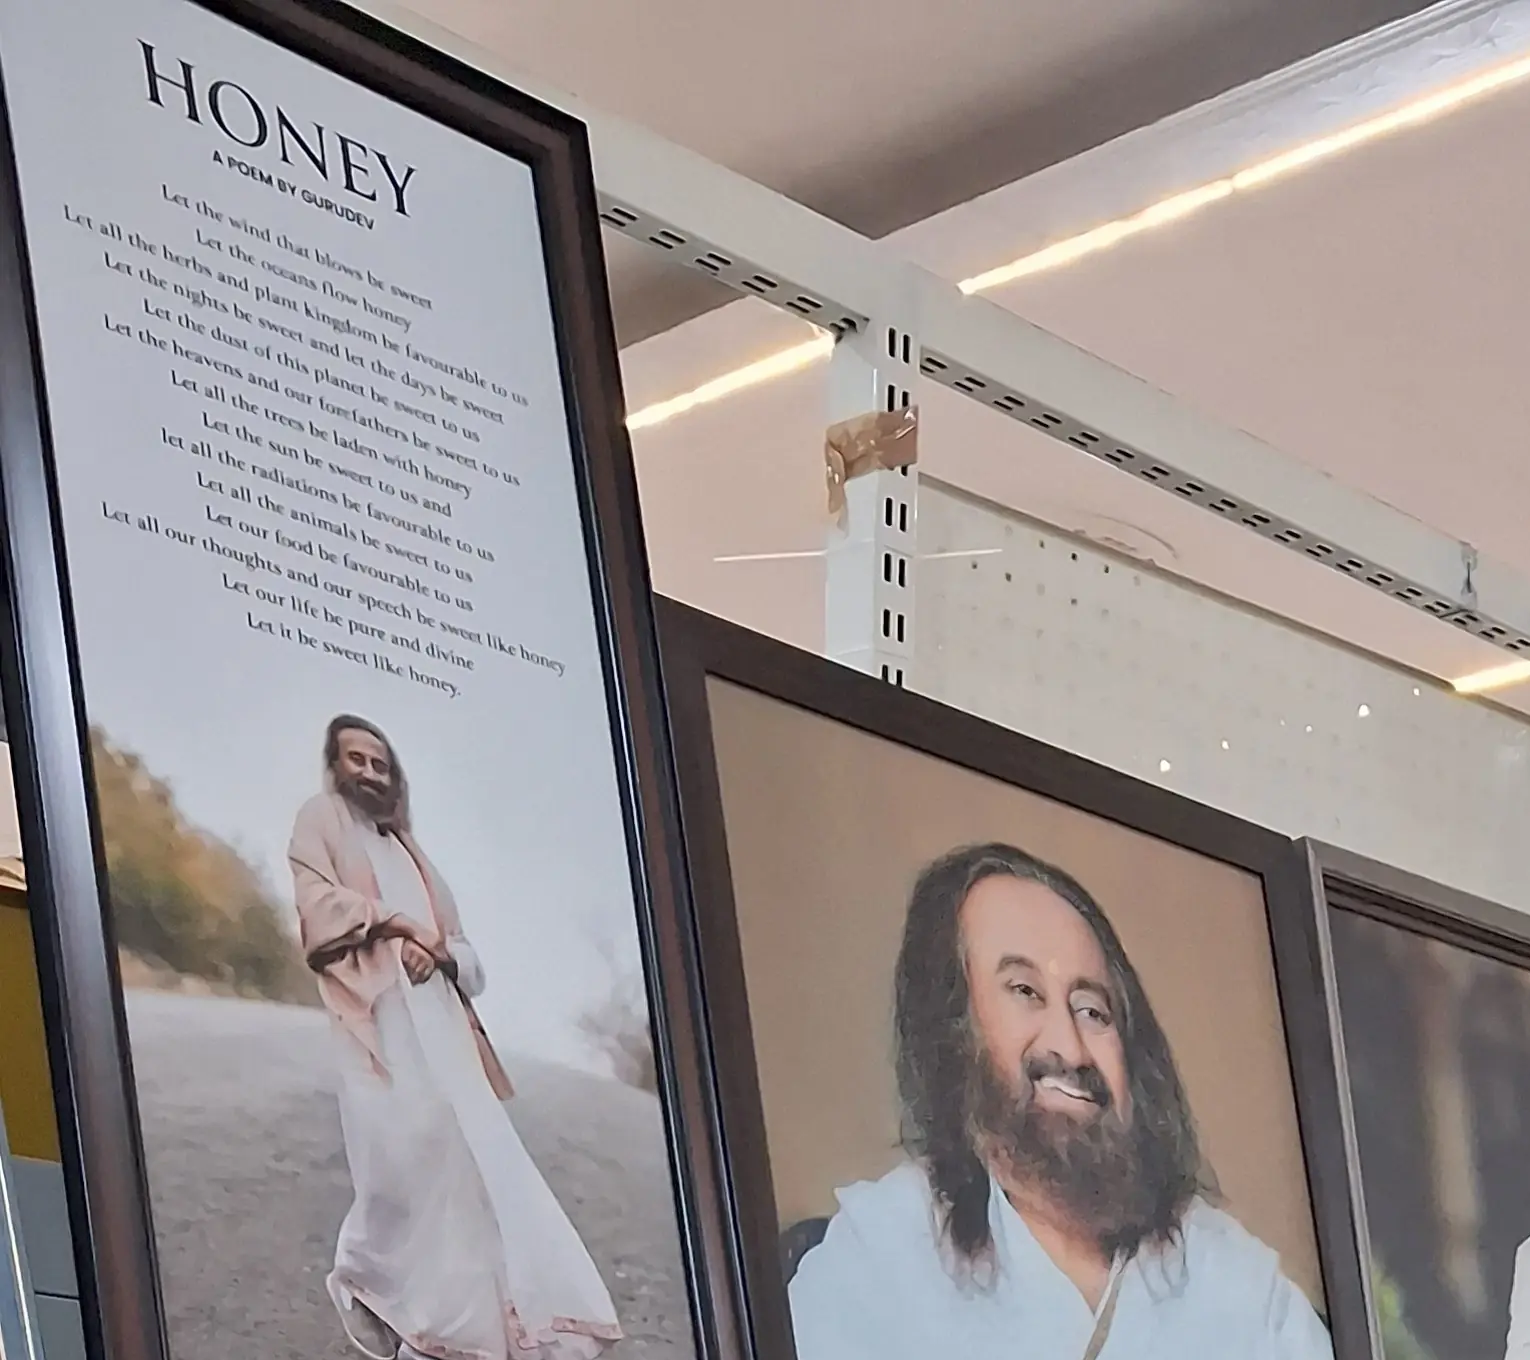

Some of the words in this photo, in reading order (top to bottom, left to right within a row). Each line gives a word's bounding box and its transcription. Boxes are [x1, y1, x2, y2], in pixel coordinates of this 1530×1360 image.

[136, 38, 418, 218] HONEY
[212, 149, 225, 166] A
[225, 152, 275, 188] POEM
[276, 176, 299, 198] BY
[300, 188, 375, 230] GURUDEV
[63, 204, 93, 232] Let
[99, 221, 123, 242] all
[127, 232, 158, 256] the
[162, 243, 213, 279] herbs
[216, 271, 249, 293] and
[253, 285, 299, 313] plant
[303, 300, 378, 345] kingdom
[381, 332, 400, 354] be
[405, 342, 487, 389] favourable
[491, 382, 508, 398] to
[511, 392, 528, 406] us
[161, 183, 190, 209] Let
[195, 200, 224, 224] the
[228, 216, 271, 244] wind
[275, 234, 310, 261] that
[314, 248, 363, 281] blows
[366, 269, 385, 291] be
[390, 285, 432, 310] sweet
[195, 227, 224, 253] Let
[228, 243, 256, 266] the
[260, 259, 318, 291] oceans
[321, 280, 358, 306] flow
[361, 296, 411, 334] honey
[103, 250, 133, 277] Let
[138, 267, 168, 291] the
[172, 282, 229, 314] nights
[232, 301, 253, 324] be
[257, 316, 304, 344] sweet
[309, 337, 340, 359] and
[343, 346, 365, 369] let
[370, 358, 396, 381] the
[400, 370, 437, 397] days
[439, 384, 458, 406] be
[462, 399, 504, 425] sweet
[103, 313, 132, 338] Let
[137, 328, 168, 352] the
[171, 338, 244, 380] heavens
[247, 372, 280, 393] and
[283, 386, 313, 406] our
[412, 430, 431, 451] be
[434, 445, 478, 471] sweet
[482, 462, 499, 478] to
[501, 471, 520, 486] us
[143, 297, 172, 323] Let
[177, 312, 206, 336] the
[210, 325, 249, 352] dust
[253, 345, 271, 361] of
[276, 351, 310, 375] this
[313, 367, 366, 398] planet
[369, 385, 389, 407] be
[393, 400, 437, 426] sweet
[441, 417, 458, 434] to
[461, 427, 480, 443] us
[161, 426, 185, 451] let
[190, 440, 212, 460] all
[213, 448, 249, 473] the
[251, 463, 339, 505] radiations
[341, 492, 362, 514] be
[366, 501, 452, 547] favourable
[455, 538, 473, 555] to
[476, 547, 495, 562] us
[170, 368, 202, 397] Let
[203, 384, 226, 404] all
[230, 392, 260, 416] the
[263, 407, 305, 433] trees
[307, 419, 329, 442] be
[332, 428, 378, 460] laden
[382, 452, 420, 477] with
[423, 463, 472, 500] honey
[201, 410, 232, 436] Let
[234, 424, 263, 447] the
[268, 440, 299, 460] sun
[302, 447, 324, 469] be
[327, 461, 374, 489] sweet
[377, 479, 396, 496] to
[399, 488, 419, 505] us
[422, 497, 452, 518] and
[101, 500, 131, 525] Let
[136, 514, 160, 535] all
[164, 527, 197, 546] our
[201, 536, 283, 576] thoughts
[286, 568, 319, 589] and
[322, 580, 353, 599] our
[357, 592, 413, 621] speech
[415, 607, 436, 628] be
[439, 620, 483, 645] sweet
[486, 632, 517, 657] like
[519, 643, 565, 677] honey
[196, 470, 225, 495] Let
[230, 484, 252, 504] all
[252, 491, 285, 516] the
[289, 508, 358, 542] animals
[359, 527, 381, 550] be
[384, 542, 429, 567] sweet
[433, 559, 451, 575] to
[454, 567, 473, 583] us
[205, 504, 234, 529] Let
[238, 520, 269, 540] our
[274, 528, 314, 557] food
[317, 543, 338, 565] be
[342, 552, 430, 597] favourable
[433, 588, 451, 604] to
[454, 597, 474, 612] us
[221, 571, 250, 596] Let
[255, 588, 286, 607] our
[290, 594, 319, 619] life
[322, 605, 344, 628] be
[347, 618, 387, 642] pure
[390, 633, 421, 653] and
[424, 641, 474, 671] divine
[246, 611, 276, 636] Let
[279, 621, 293, 641] it
[296, 627, 318, 649] be
[321, 640, 369, 666] sweet
[372, 651, 405, 677] like
[408, 664, 461, 699] honey.
